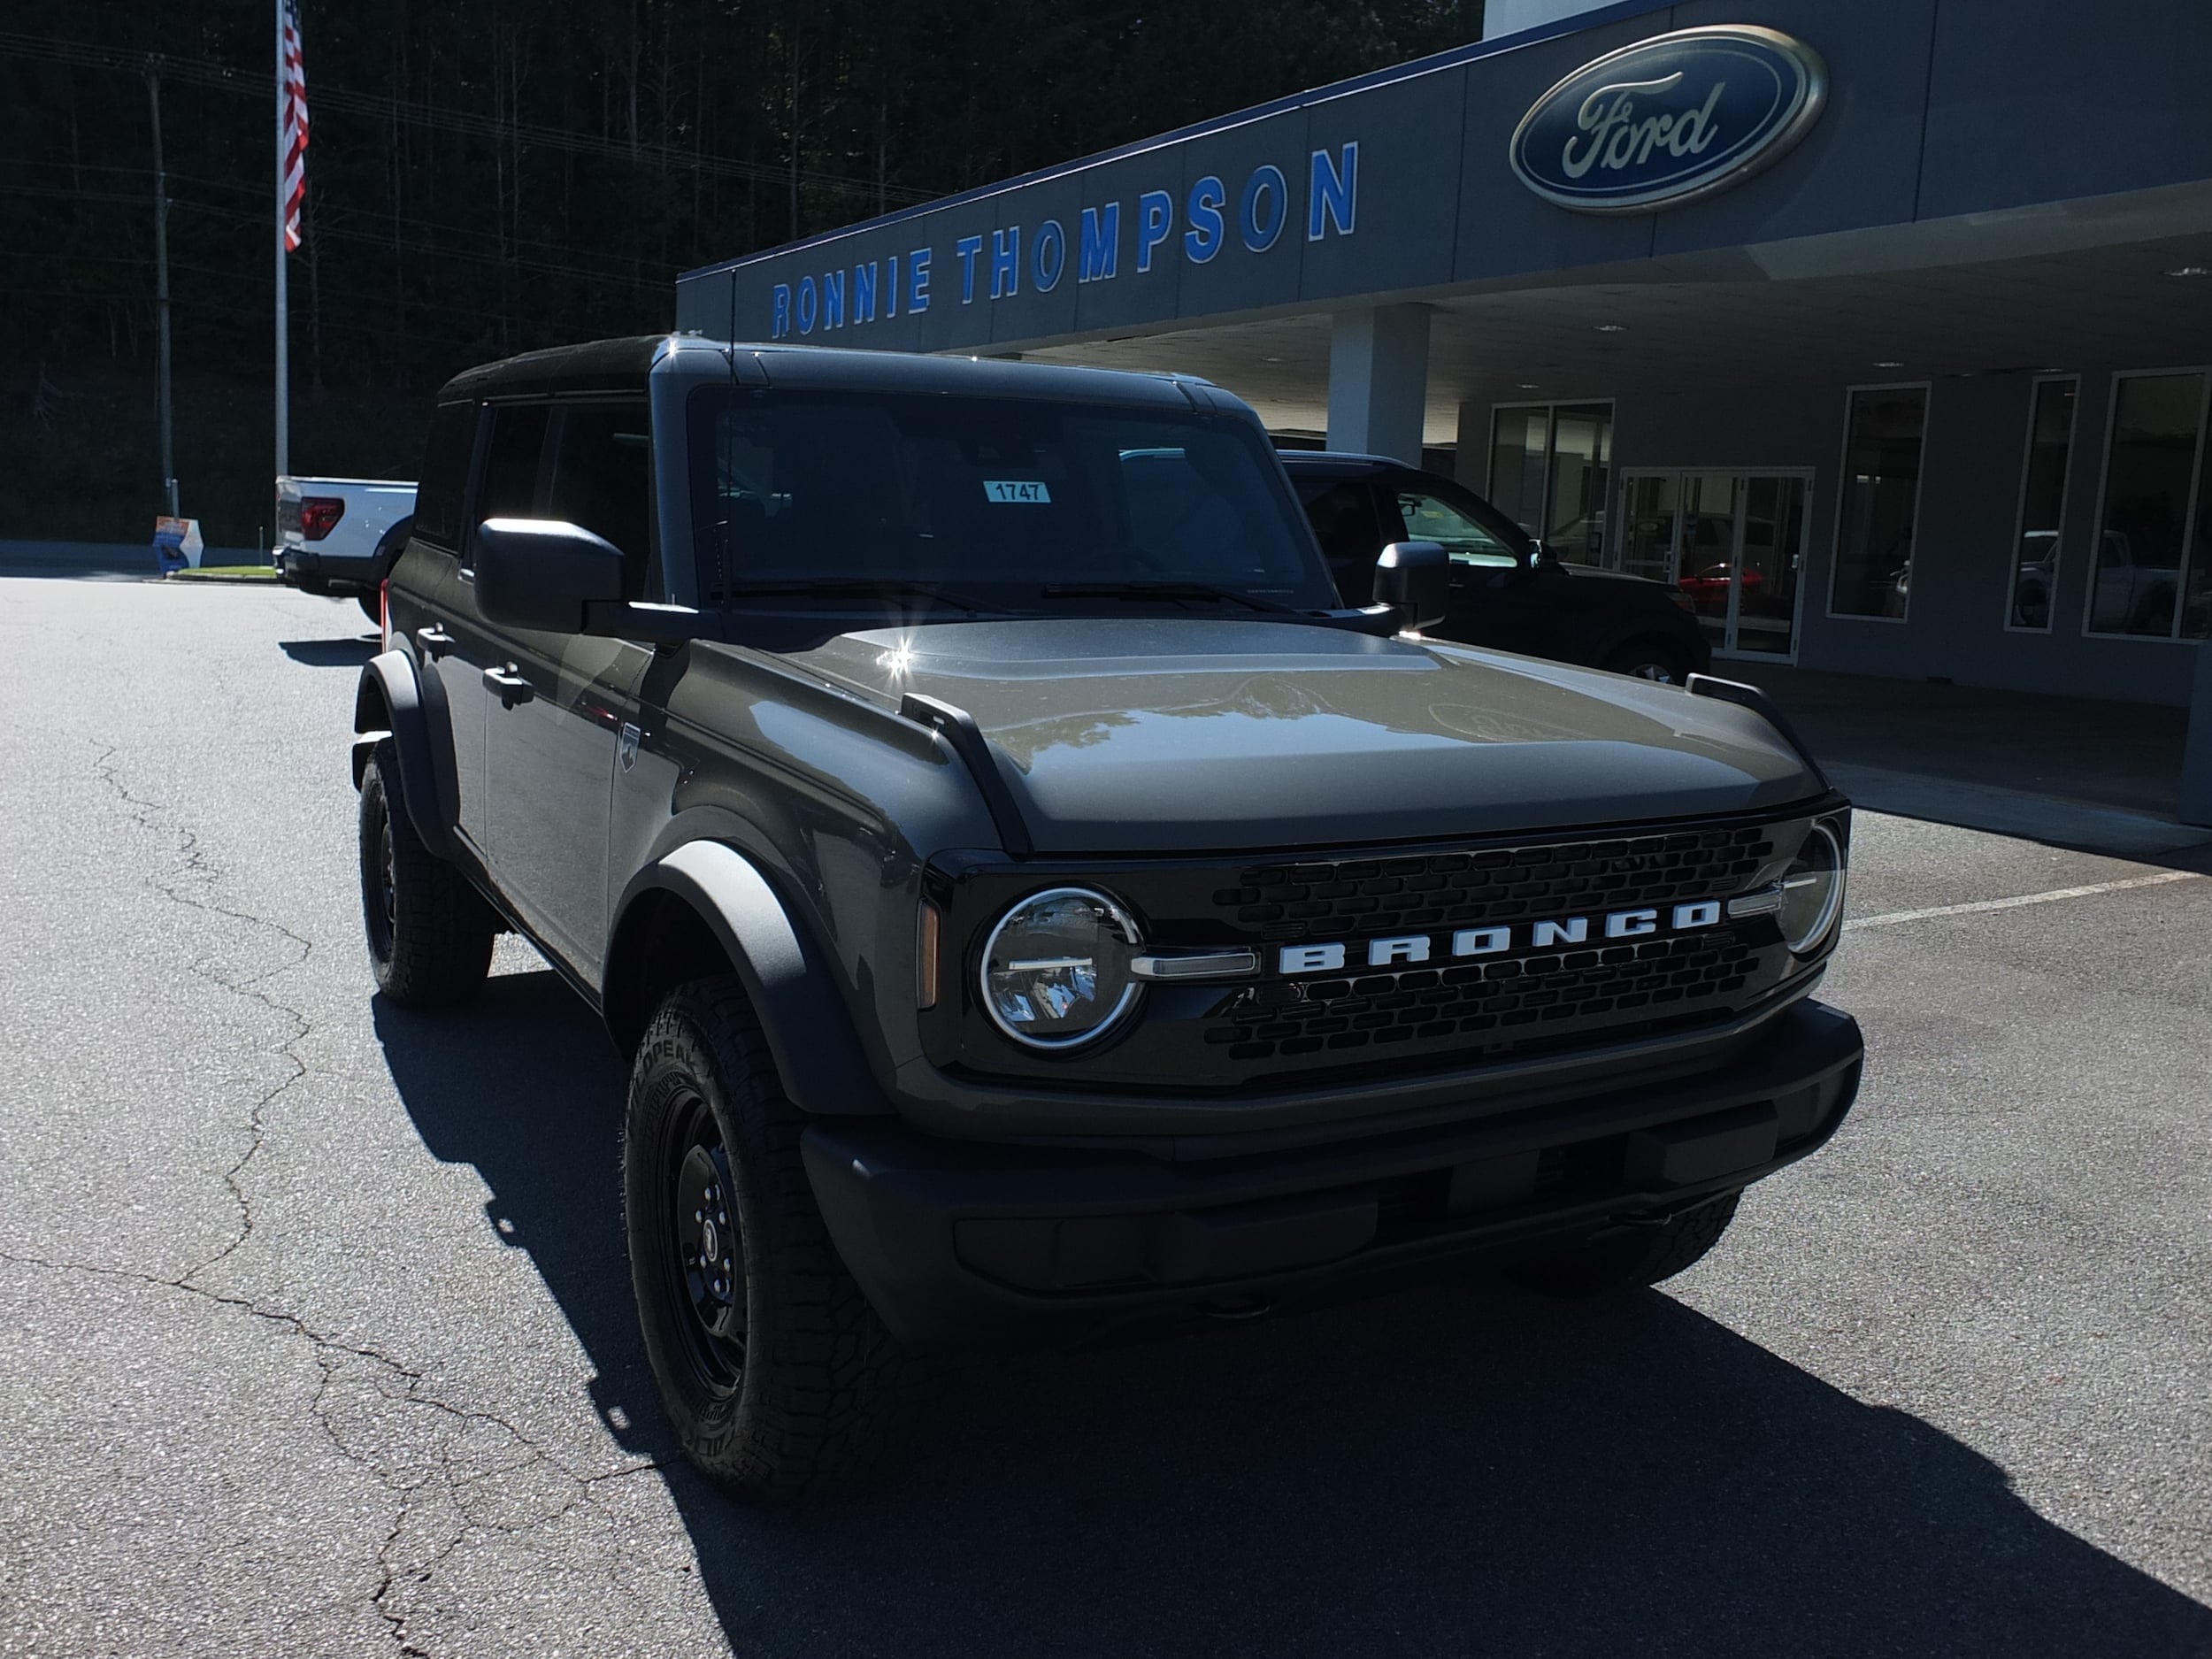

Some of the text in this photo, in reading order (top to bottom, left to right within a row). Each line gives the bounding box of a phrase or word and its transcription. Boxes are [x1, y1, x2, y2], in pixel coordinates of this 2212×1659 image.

[1562, 71, 1725, 178] Ford
[772, 140, 1360, 340] RONNIE THOMPSON
[995, 483, 1039, 501] 1747
[1279, 899, 1721, 974] BRONCO
